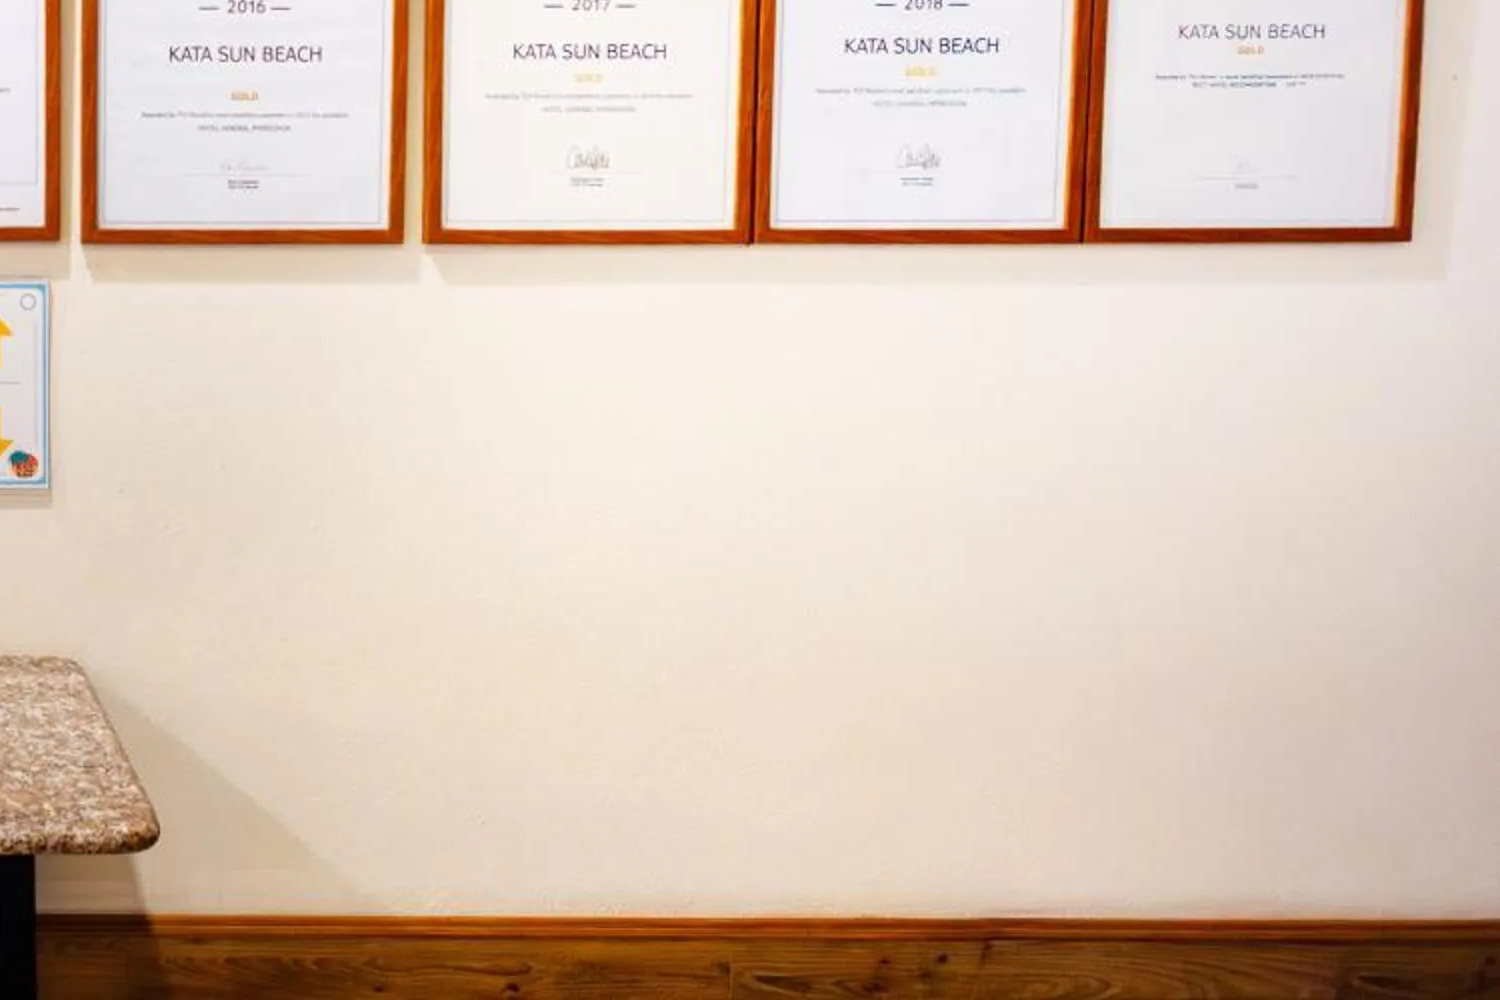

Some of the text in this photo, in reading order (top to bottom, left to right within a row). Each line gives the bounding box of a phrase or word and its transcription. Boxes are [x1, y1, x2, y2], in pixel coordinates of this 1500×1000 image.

[227, 0, 267, 13] 2016
[1177, 24, 1325, 40] KATA SUN BEACH
[513, 43, 667, 60] KATA SUN BEACH
[844, 37, 999, 54] KATA SUN BEACH
[169, 46, 322, 62] KATA SUN BEACH
